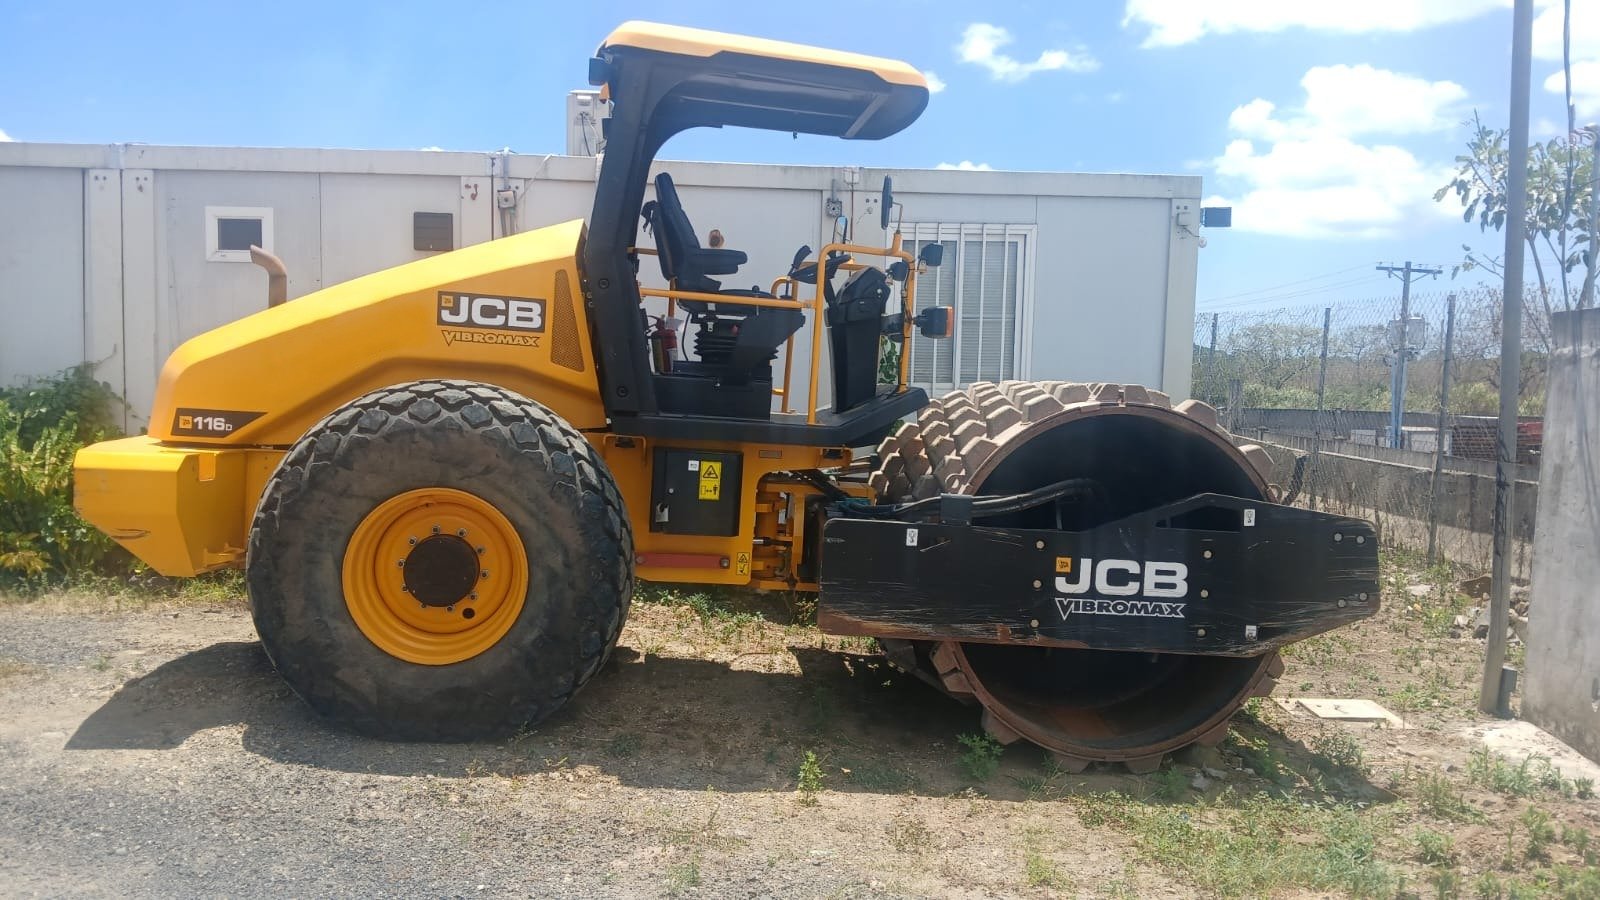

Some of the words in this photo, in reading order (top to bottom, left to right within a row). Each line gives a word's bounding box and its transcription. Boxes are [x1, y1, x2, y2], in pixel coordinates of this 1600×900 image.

[441, 296, 541, 328] JCB
[441, 330, 540, 347] VIBROMAX
[1055, 558, 1188, 598] JCB
[1054, 597, 1187, 621] VIBROMAX
